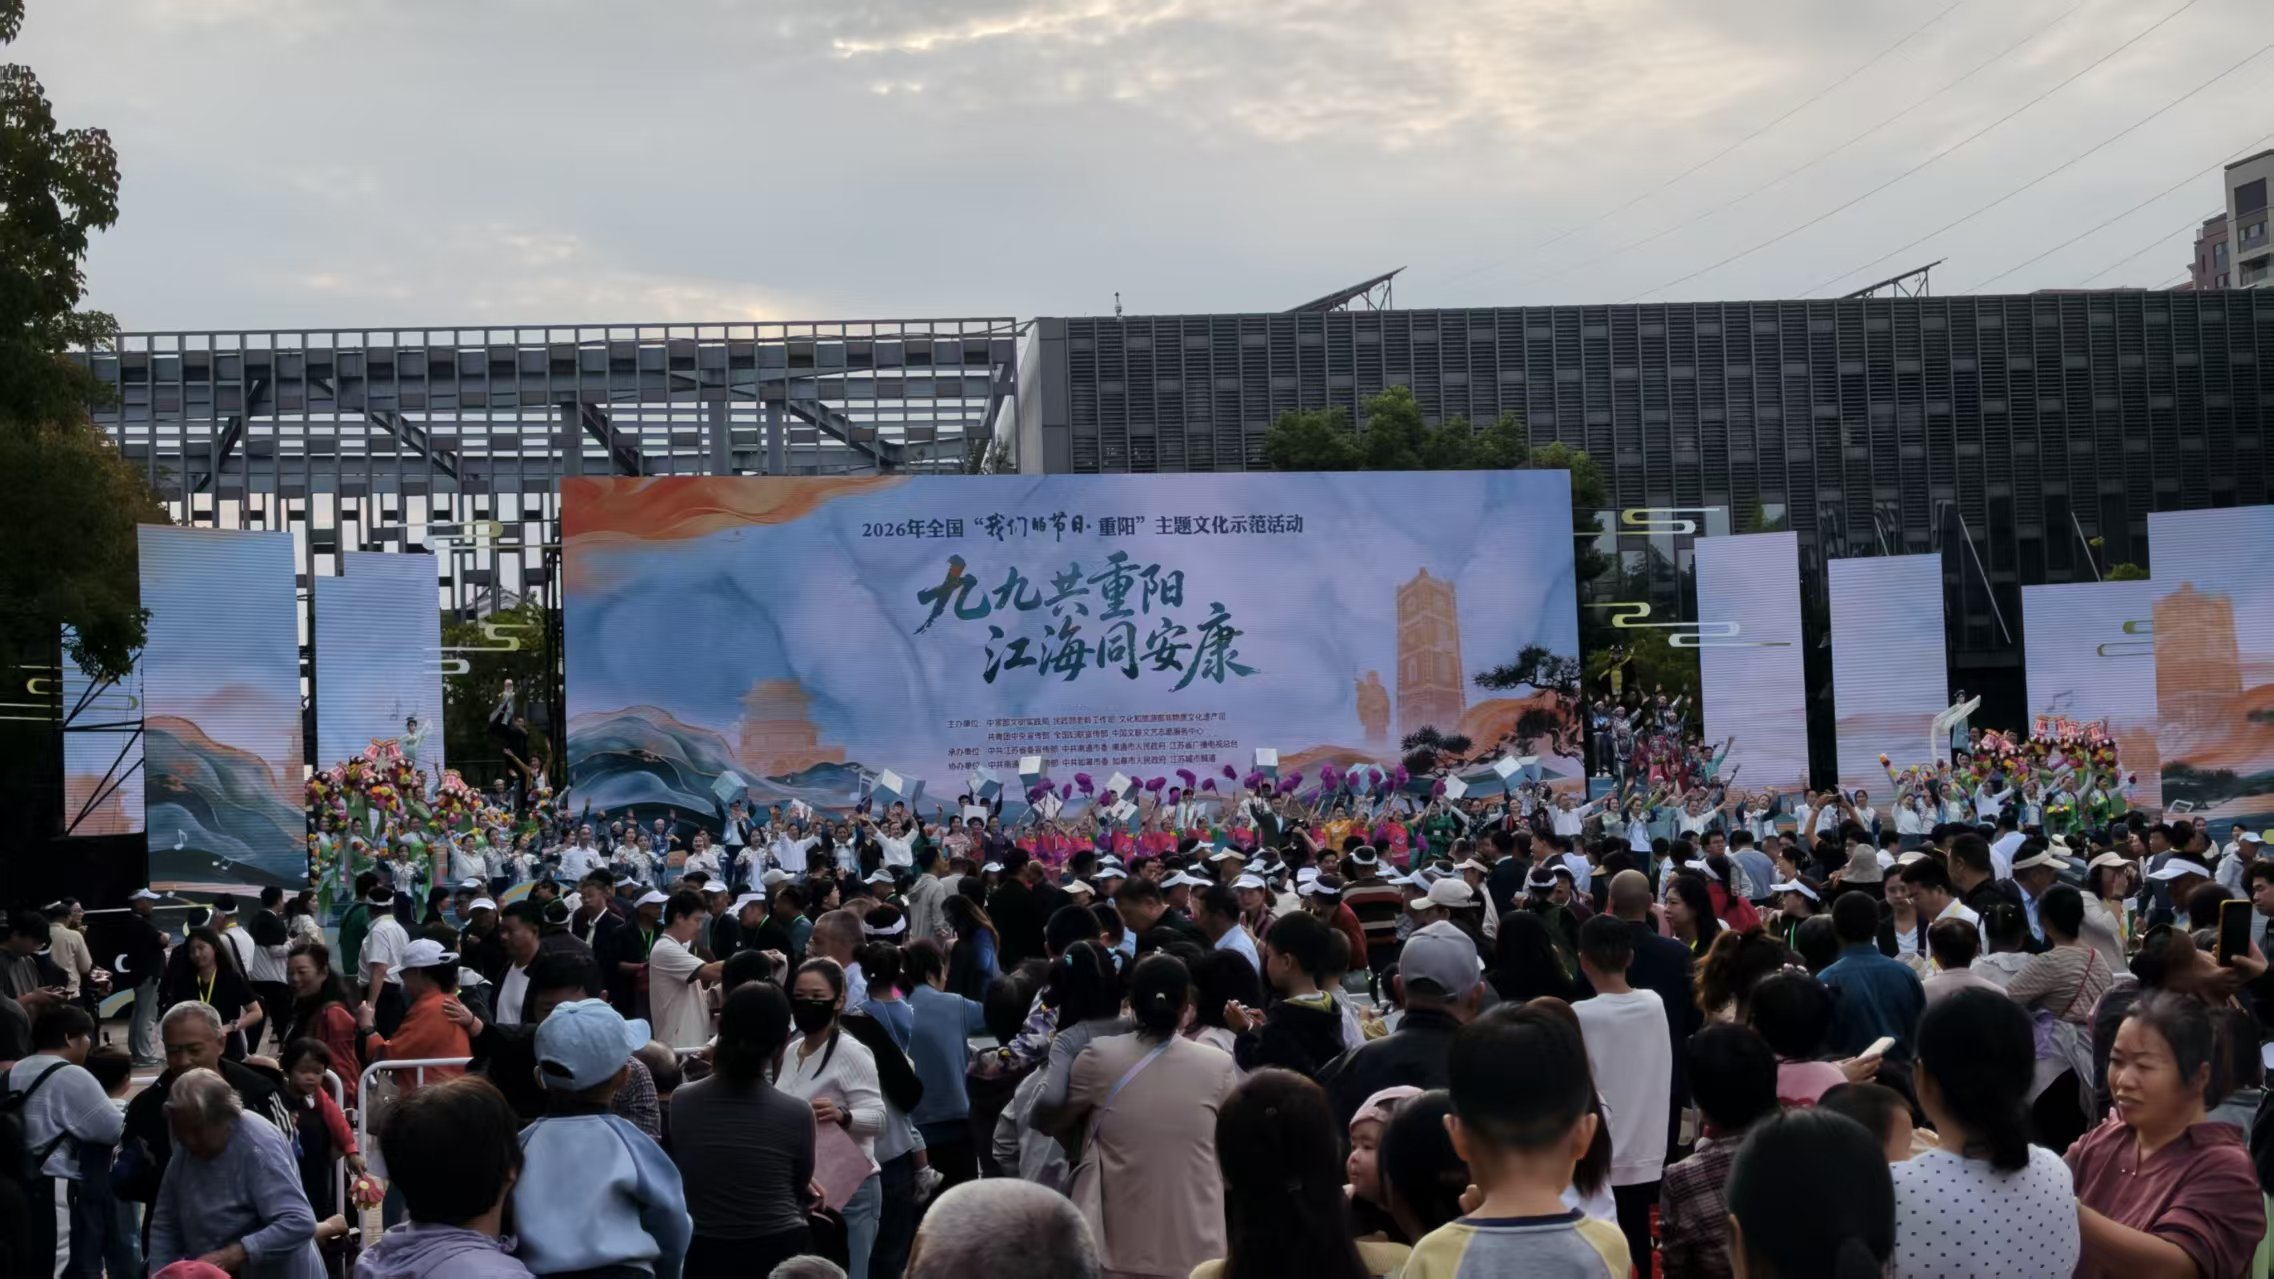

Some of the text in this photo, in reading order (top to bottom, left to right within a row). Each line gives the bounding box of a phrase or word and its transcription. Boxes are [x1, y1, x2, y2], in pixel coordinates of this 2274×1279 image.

[914, 550, 1186, 635] 九九共重阳
[981, 602, 1261, 692] 江海同安康
